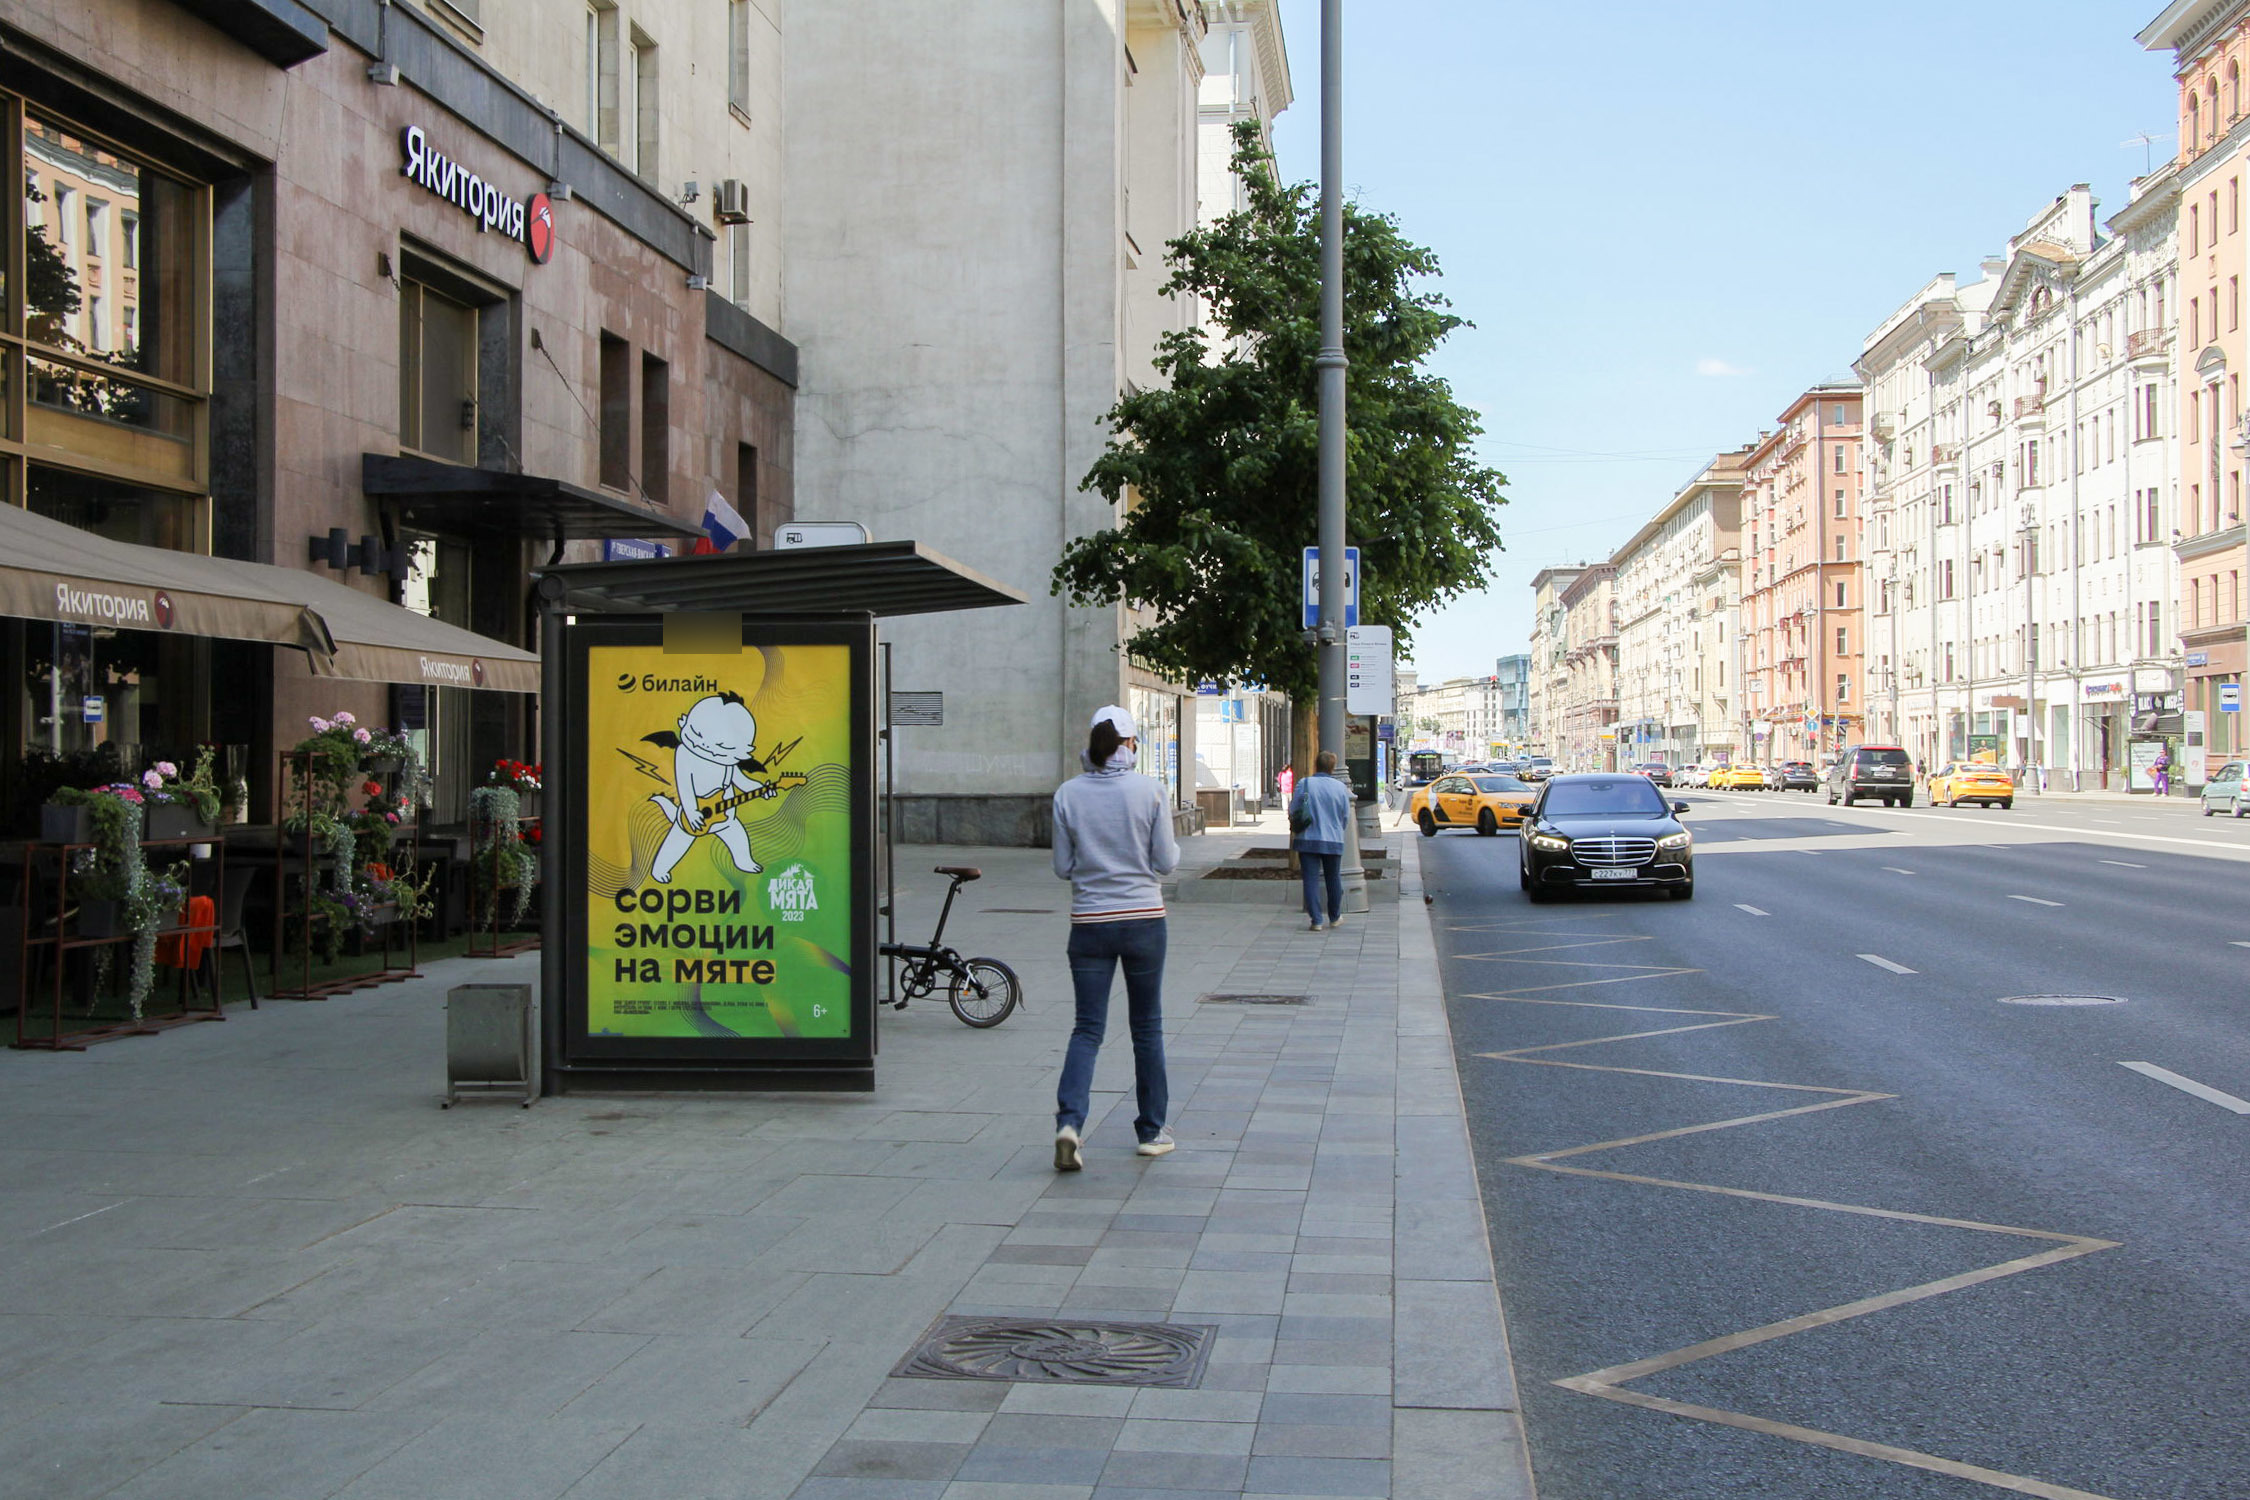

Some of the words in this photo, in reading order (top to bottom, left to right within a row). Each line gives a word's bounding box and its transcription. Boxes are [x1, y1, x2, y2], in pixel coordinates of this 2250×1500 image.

[404, 124, 525, 243] Якитория
[56, 582, 150, 625] Якитория
[420, 656, 471, 684] Якитория
[641, 673, 718, 692] билайн
[768, 878, 814, 893] ДИКАЯ
[614, 887, 741, 923] сорви
[770, 890, 819, 910] МЯТА
[782, 910, 805, 922] 2023
[614, 923, 775, 955] эмоции
[614, 958, 662, 983] на
[674, 958, 776, 985] мяте
[812, 1004, 828, 1018] 6+
